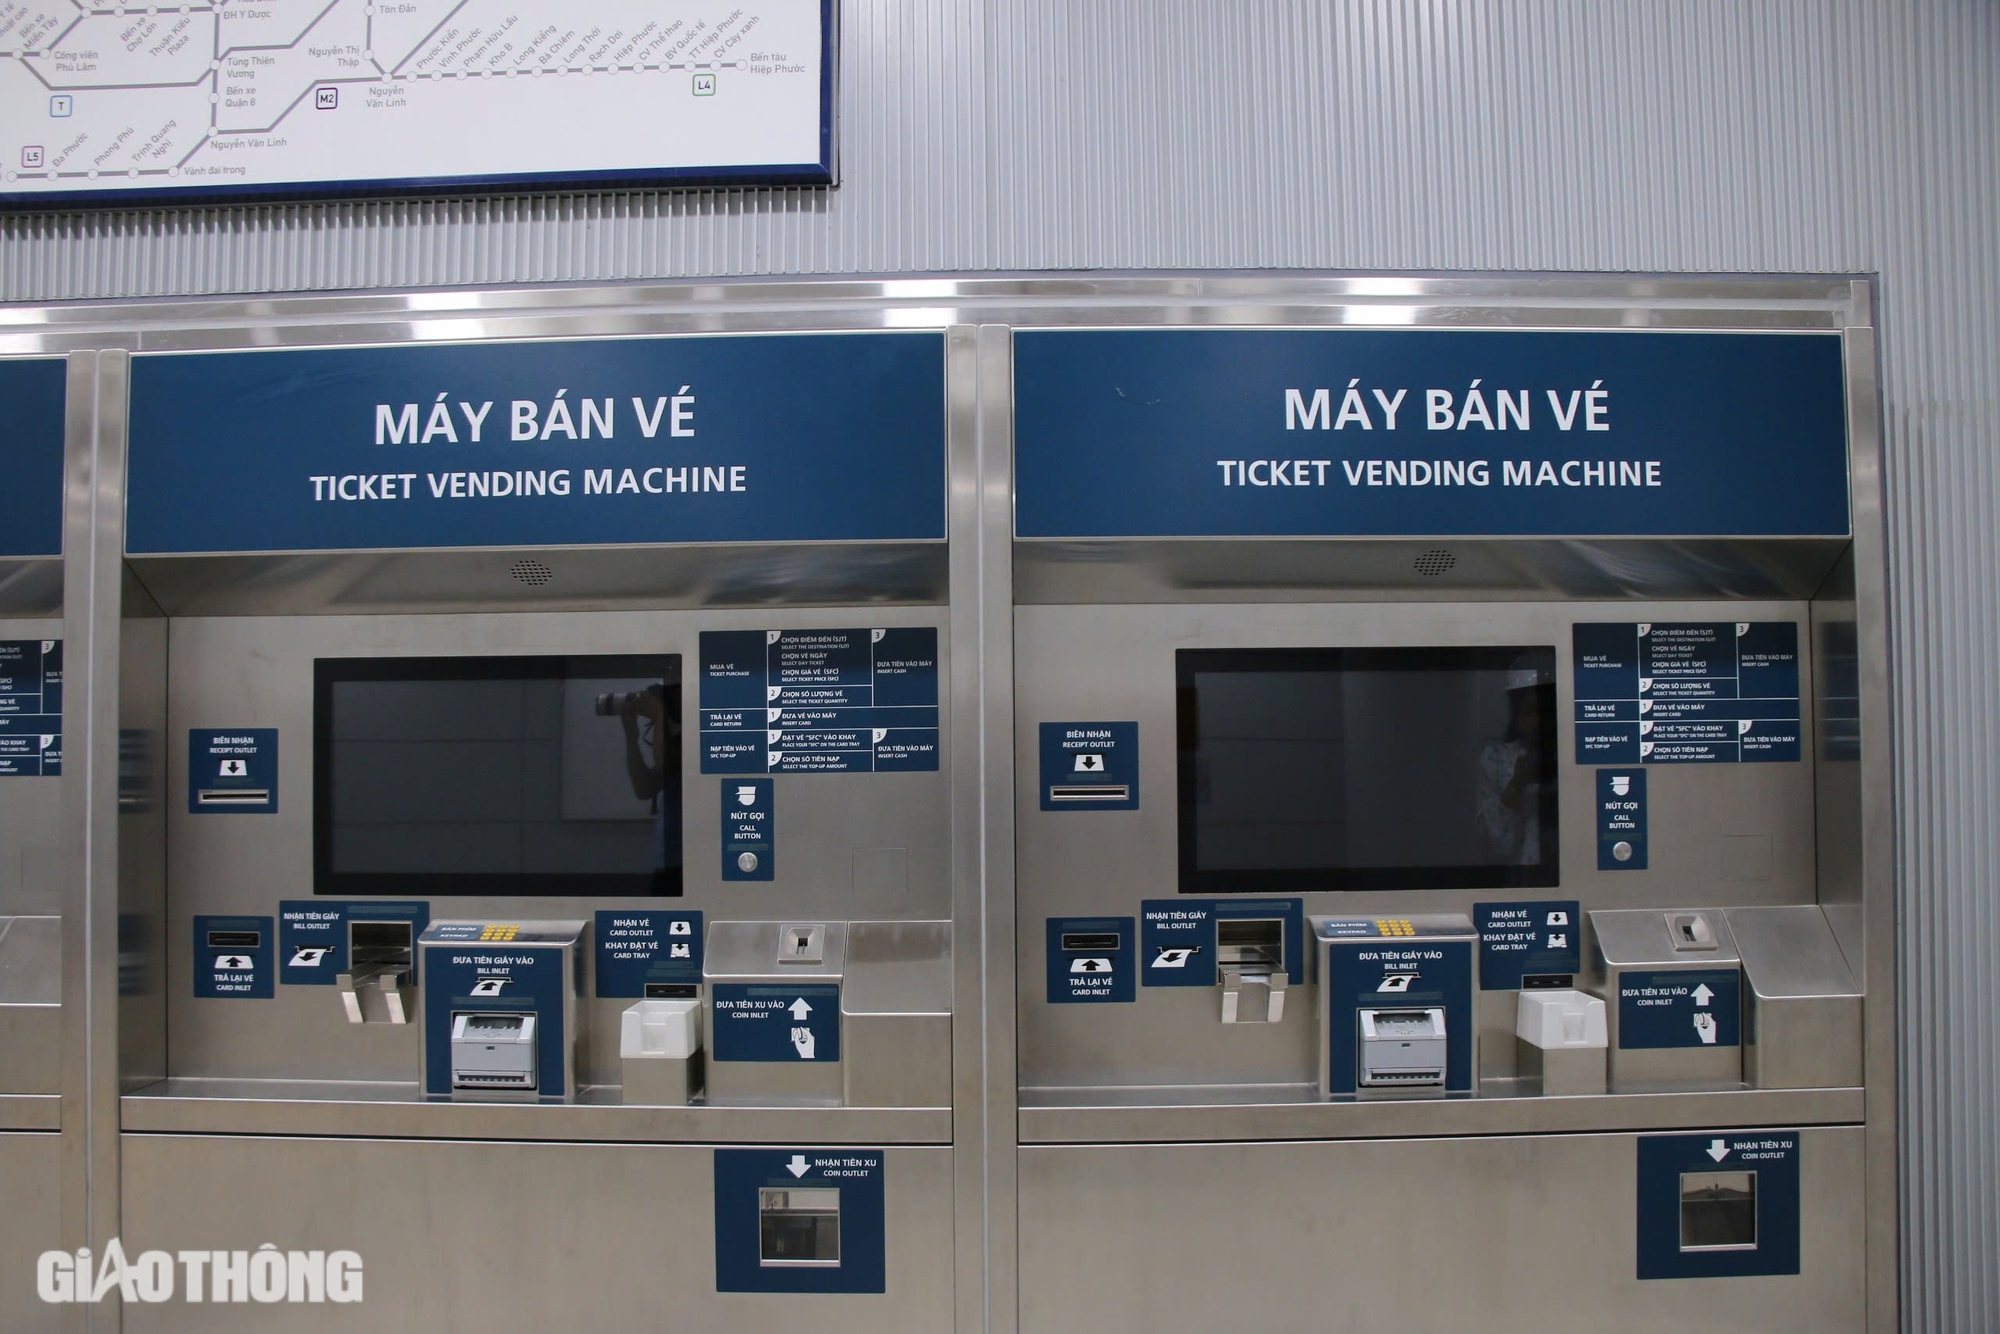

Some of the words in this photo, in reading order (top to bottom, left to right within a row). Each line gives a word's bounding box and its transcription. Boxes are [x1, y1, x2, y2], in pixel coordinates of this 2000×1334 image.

[223, 11, 237, 20] ĐH
[240, 10, 246, 18] Y
[750, 65, 772, 75] Hiệp
[775, 64, 805, 73] Phước
[698, 81, 710, 90] L4
[320, 94, 334, 103] M2
[58, 102, 64, 110] T
[267, 138, 287, 147] Linh
[27, 152, 39, 161] L5
[184, 166, 206, 175] Vành
[208, 166, 221, 175] đai
[223, 167, 246, 175] trong
[1285, 378, 1407, 430] MÁY
[1426, 379, 1530, 430] BÁN
[1546, 380, 1609, 431] VÉ
[376, 392, 493, 445] MÁY
[511, 389, 614, 441] BÁN
[632, 385, 695, 438] VÉ
[1217, 460, 1331, 486] TICKET
[1342, 460, 1489, 486] VENDING
[1503, 461, 1661, 486] MACHINE
[310, 474, 417, 501] TICKET
[427, 470, 570, 498] VENDING
[584, 466, 746, 494] MACHINE
[770, 634, 775, 642] 1
[875, 632, 880, 640] 3
[781, 691, 800, 699] CHỌN
[1067, 730, 1085, 738] BIÊN
[1087, 730, 1111, 739] NHẬN
[213, 736, 230, 744] BIÊN
[231, 737, 254, 745] NHẬN
[1606, 801, 1622, 809] NÚT
[1623, 802, 1638, 810] GỌI
[731, 811, 748, 819] NÚT
[749, 812, 764, 821] GỌI
[284, 912, 304, 921] NHẬN
[1146, 912, 1168, 921] NHẬN
[1492, 911, 1515, 919] NHẬN
[1517, 910, 1527, 918] VÉ
[614, 919, 637, 928] NHẬN
[639, 918, 649, 926] VÉ
[1508, 933, 1524, 942] ĐẶT
[1526, 932, 1536, 940] VÉ
[630, 942, 646, 951] ĐẶT
[648, 941, 658, 949] VÉ
[1424, 950, 1442, 959] VÀO
[453, 956, 472, 964] ĐƯA
[515, 956, 534, 964] VÀO
[230, 975, 242, 983] LẠI
[244, 974, 253, 982] VÉ
[1088, 978, 1100, 987] LẠI
[1102, 977, 1112, 985] VÉ
[1671, 987, 1687, 995] VÀO
[767, 1000, 784, 1008] VÀO
[1734, 1142, 1758, 1151] NHẬN
[815, 1158, 840, 1168] NHẬN
